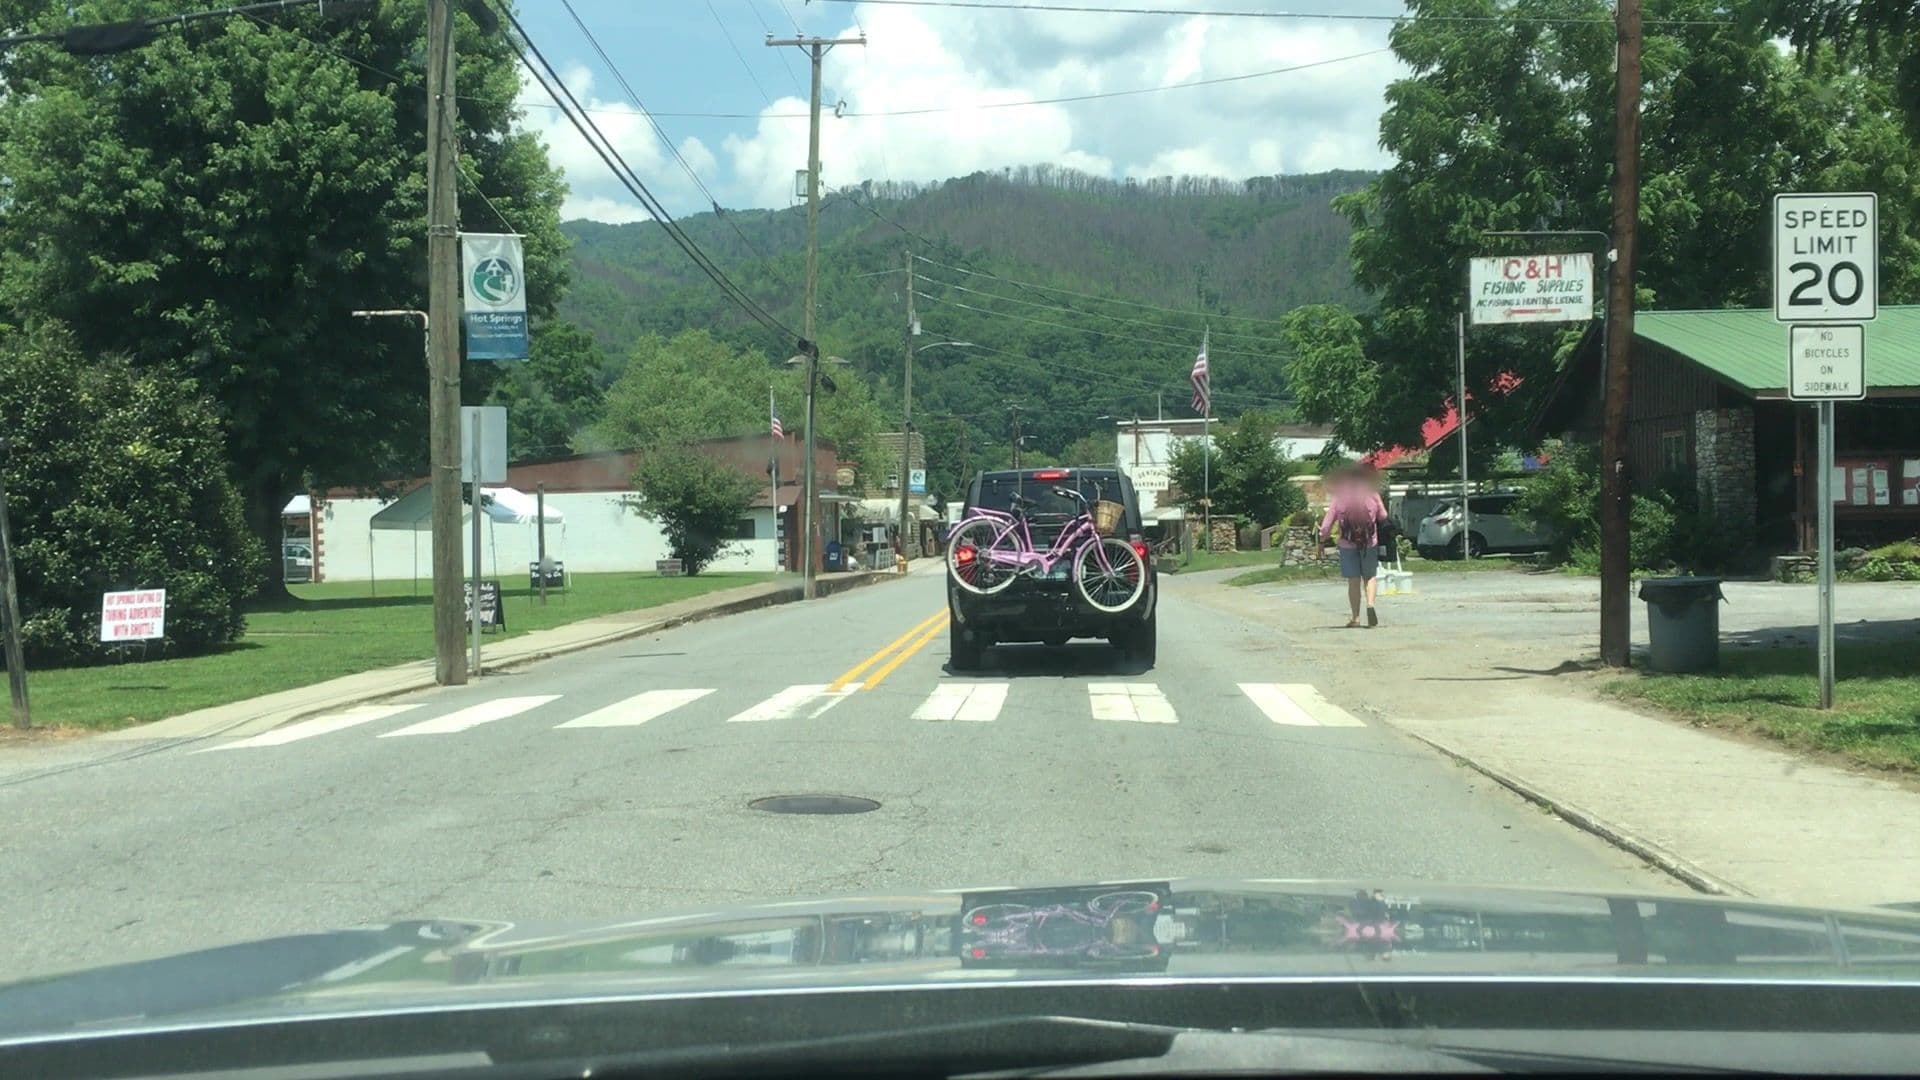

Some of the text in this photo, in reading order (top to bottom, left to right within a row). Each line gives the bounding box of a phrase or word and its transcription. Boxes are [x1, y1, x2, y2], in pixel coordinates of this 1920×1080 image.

[1784, 210, 1868, 229] SPEED
[1793, 236, 1858, 255] LIMIT
[1482, 279, 1584, 295] FISHING SUPPLIES
[1788, 261, 1864, 306] 20
[1487, 298, 1514, 307] FISHING
[1522, 297, 1554, 306] HUNTING
[471, 313, 523, 325] Hot Springs
[1820, 331, 1833, 341] NO
[1804, 348, 1850, 358] BICYCLES
[1820, 365, 1833, 375] ON
[1804, 382, 1850, 392] SIDEWALK
[129, 606, 162, 619] ADVENTURE
[113, 622, 154, 637] WITH SHUTTLE
